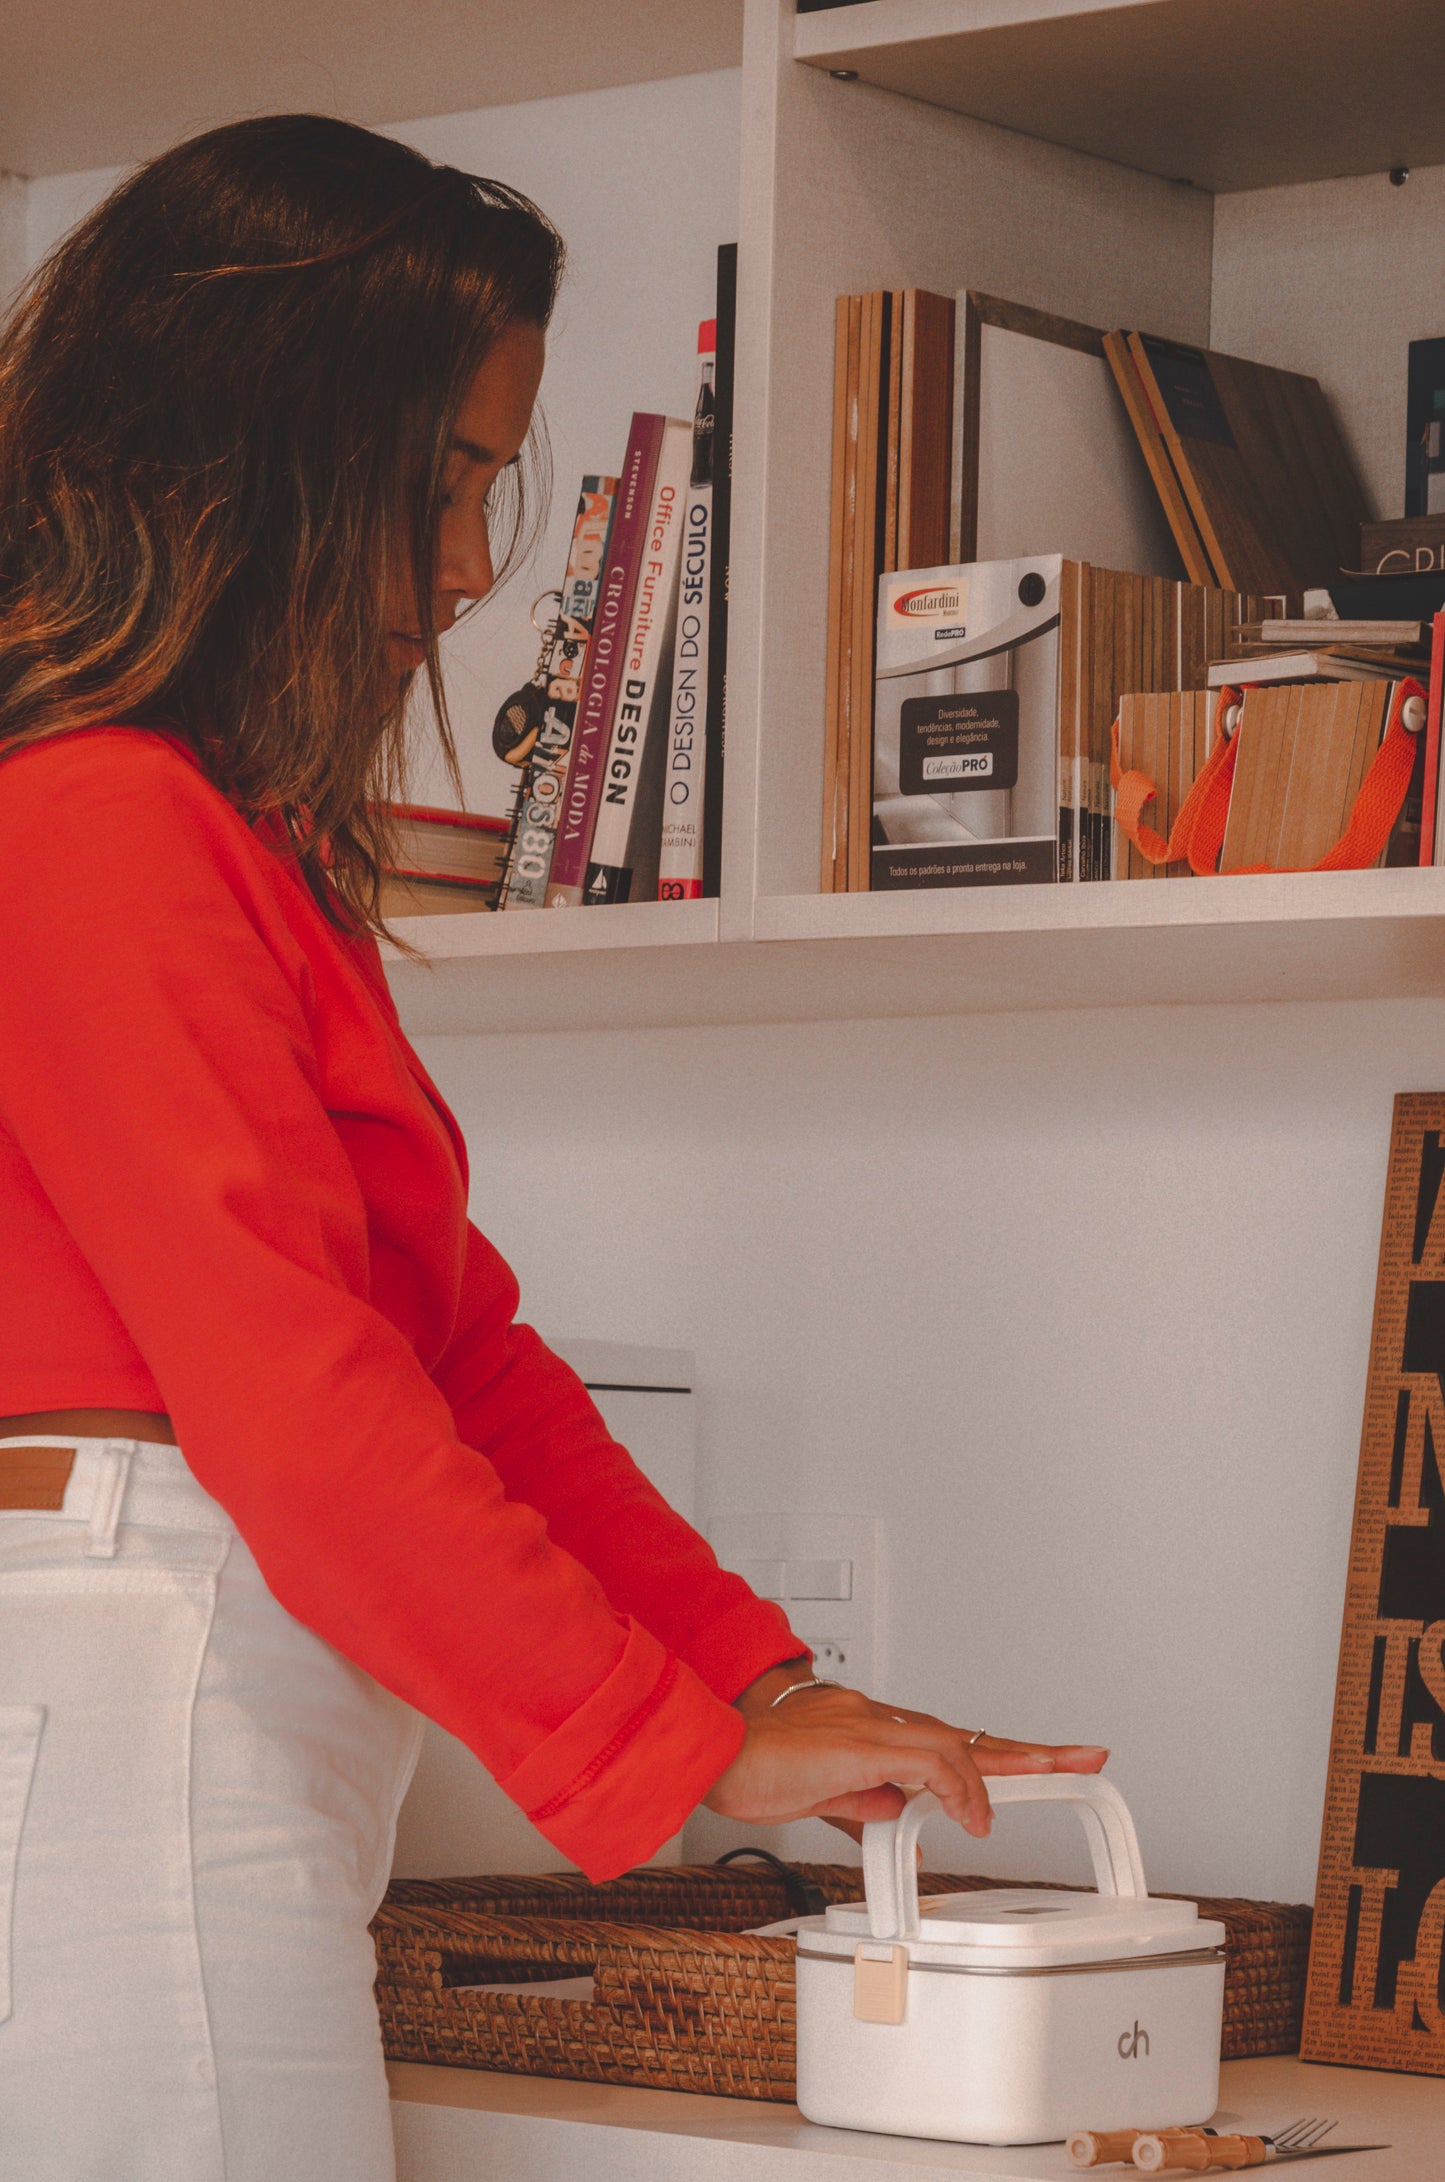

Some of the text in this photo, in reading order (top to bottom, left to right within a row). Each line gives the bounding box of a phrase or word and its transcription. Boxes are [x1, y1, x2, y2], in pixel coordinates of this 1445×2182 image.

[624, 450, 642, 519] STEVENSON
[605, 487, 676, 805] Office Furniture DESIGN
[670, 504, 708, 805] O DESIGN DO SÉCULO
[564, 566, 625, 840] CRONOLOGIA da MODA
[938, 707, 979, 720] Diversidade,
[917, 718, 1001, 734] tendências, modernidade,
[926, 732, 990, 747] design e elegância.
[889, 866, 908, 877] Todos
[909, 867, 917, 876] os
[918, 864, 945, 877] padrões
[952, 863, 974, 875] pronta
[975, 862, 1001, 873] entrega
[1002, 862, 1011, 871] na
